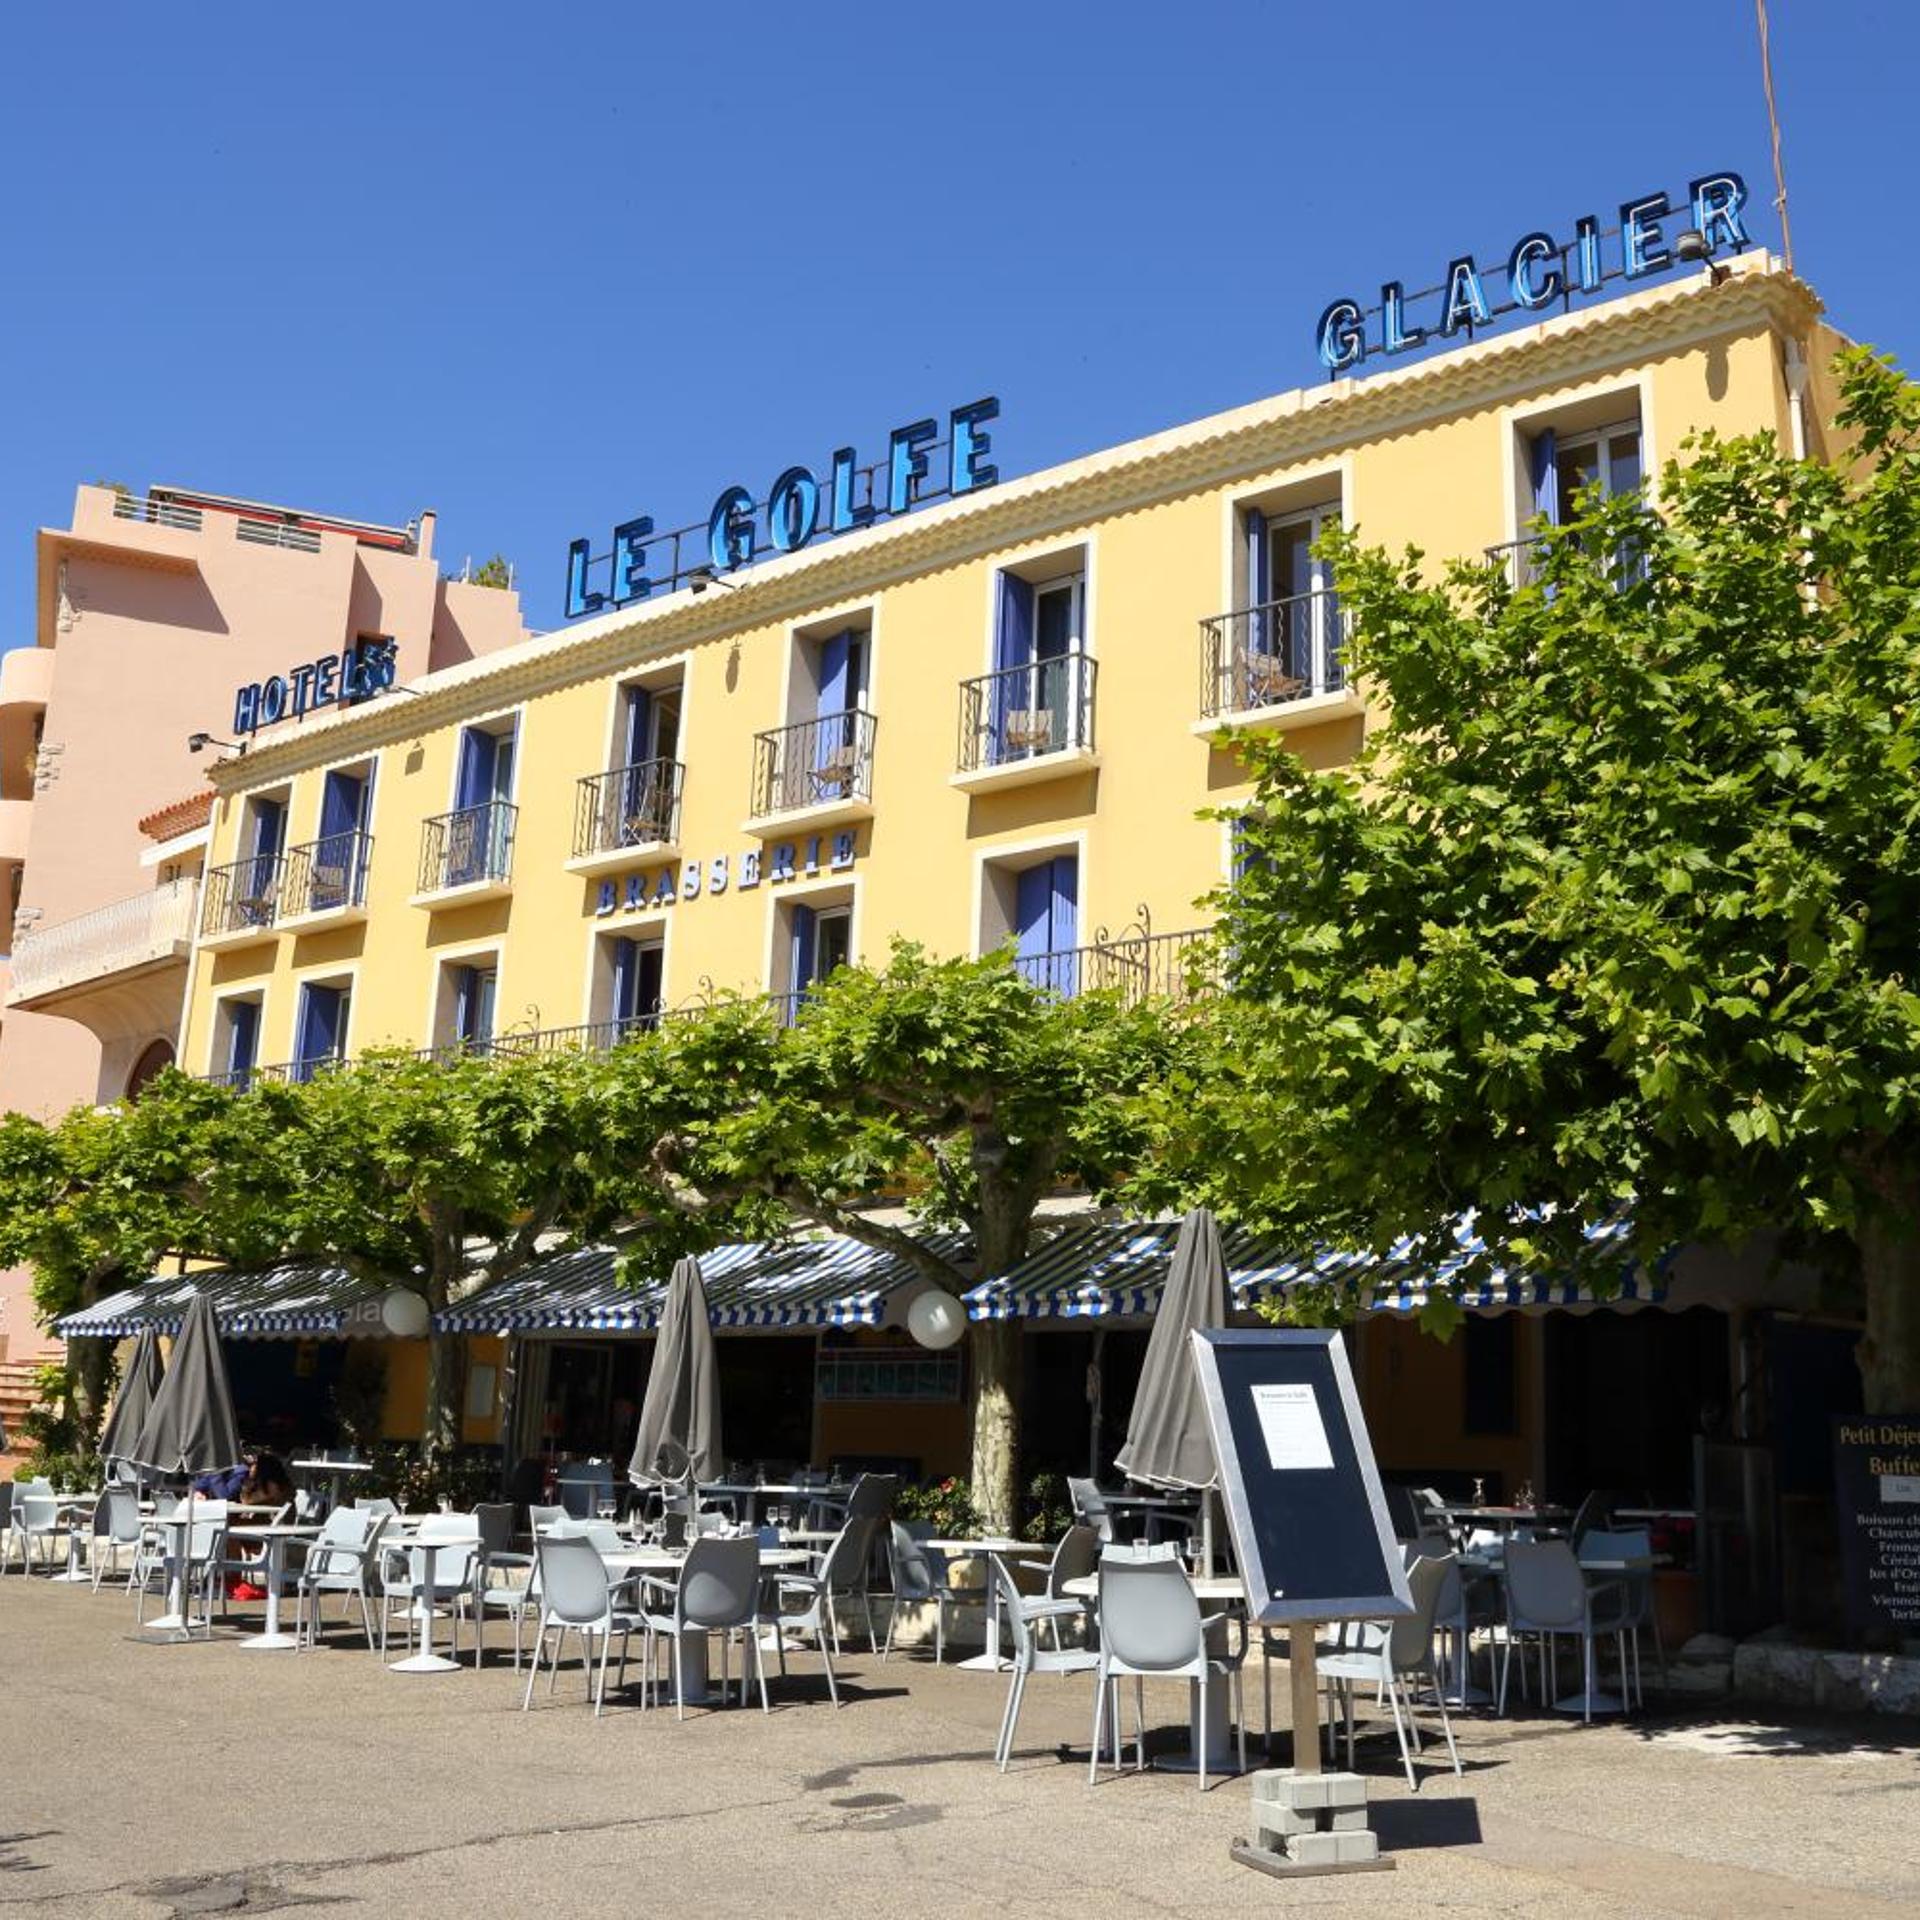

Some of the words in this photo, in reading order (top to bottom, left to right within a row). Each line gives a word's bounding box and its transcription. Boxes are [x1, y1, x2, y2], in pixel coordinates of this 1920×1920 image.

[1316, 170, 1749, 370] GLACIER
[564, 515, 654, 619] LE
[708, 395, 1000, 570] GOLFE
[234, 647, 358, 735] HOTEL
[596, 829, 857, 917] BRASSERIE
[1840, 1425, 1877, 1446] Petit
[1856, 1513, 1904, 1526] Boisson
